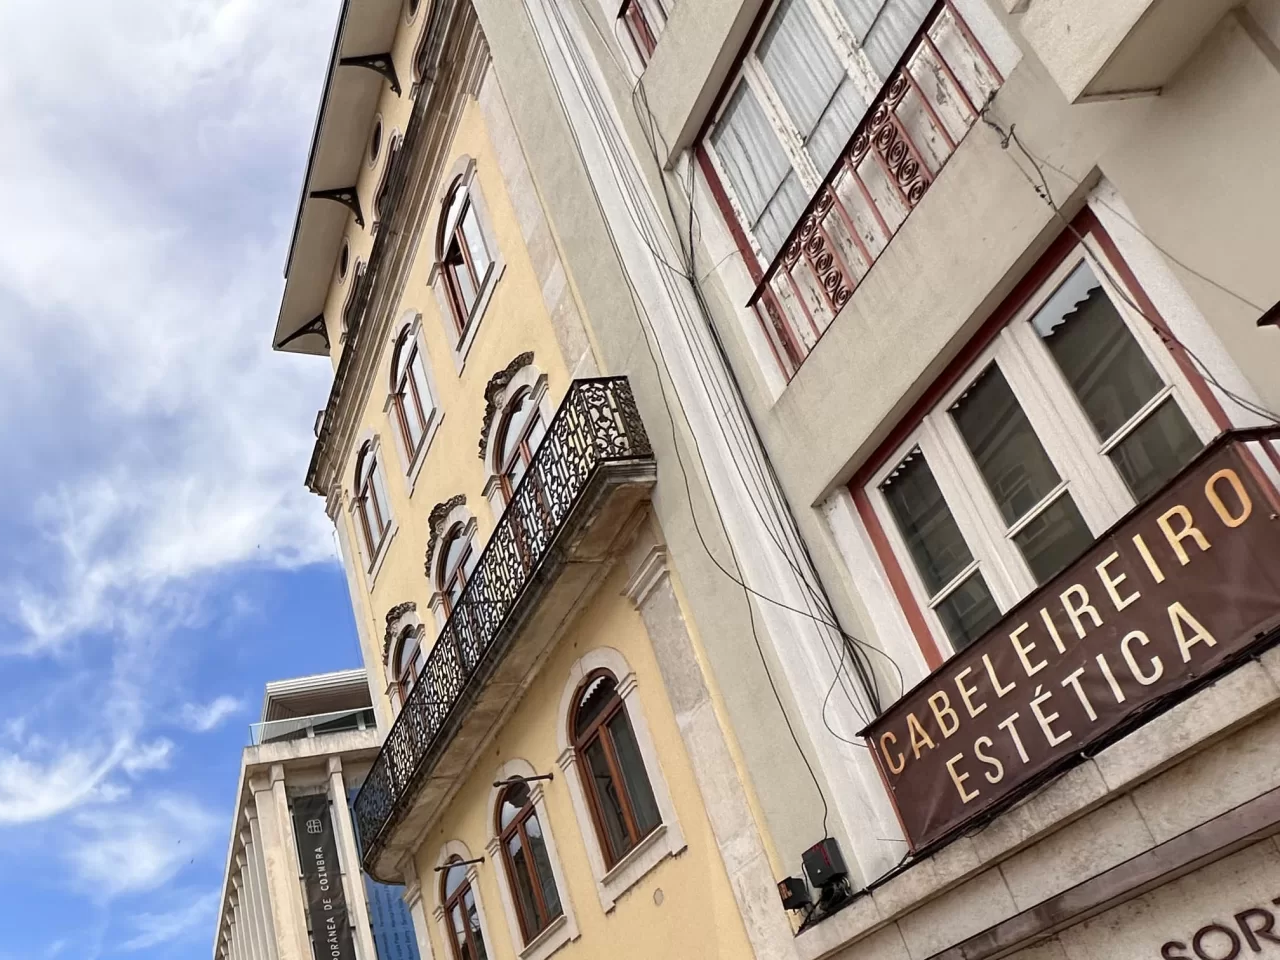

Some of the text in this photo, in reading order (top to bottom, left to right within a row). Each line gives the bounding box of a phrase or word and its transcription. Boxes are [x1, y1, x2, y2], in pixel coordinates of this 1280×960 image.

[879, 468, 1253, 776] CABELEIREIRO
[945, 600, 1218, 804] ESTÉTICA
[314, 846, 329, 892] COIMBRA
[323, 897, 333, 911] DE
